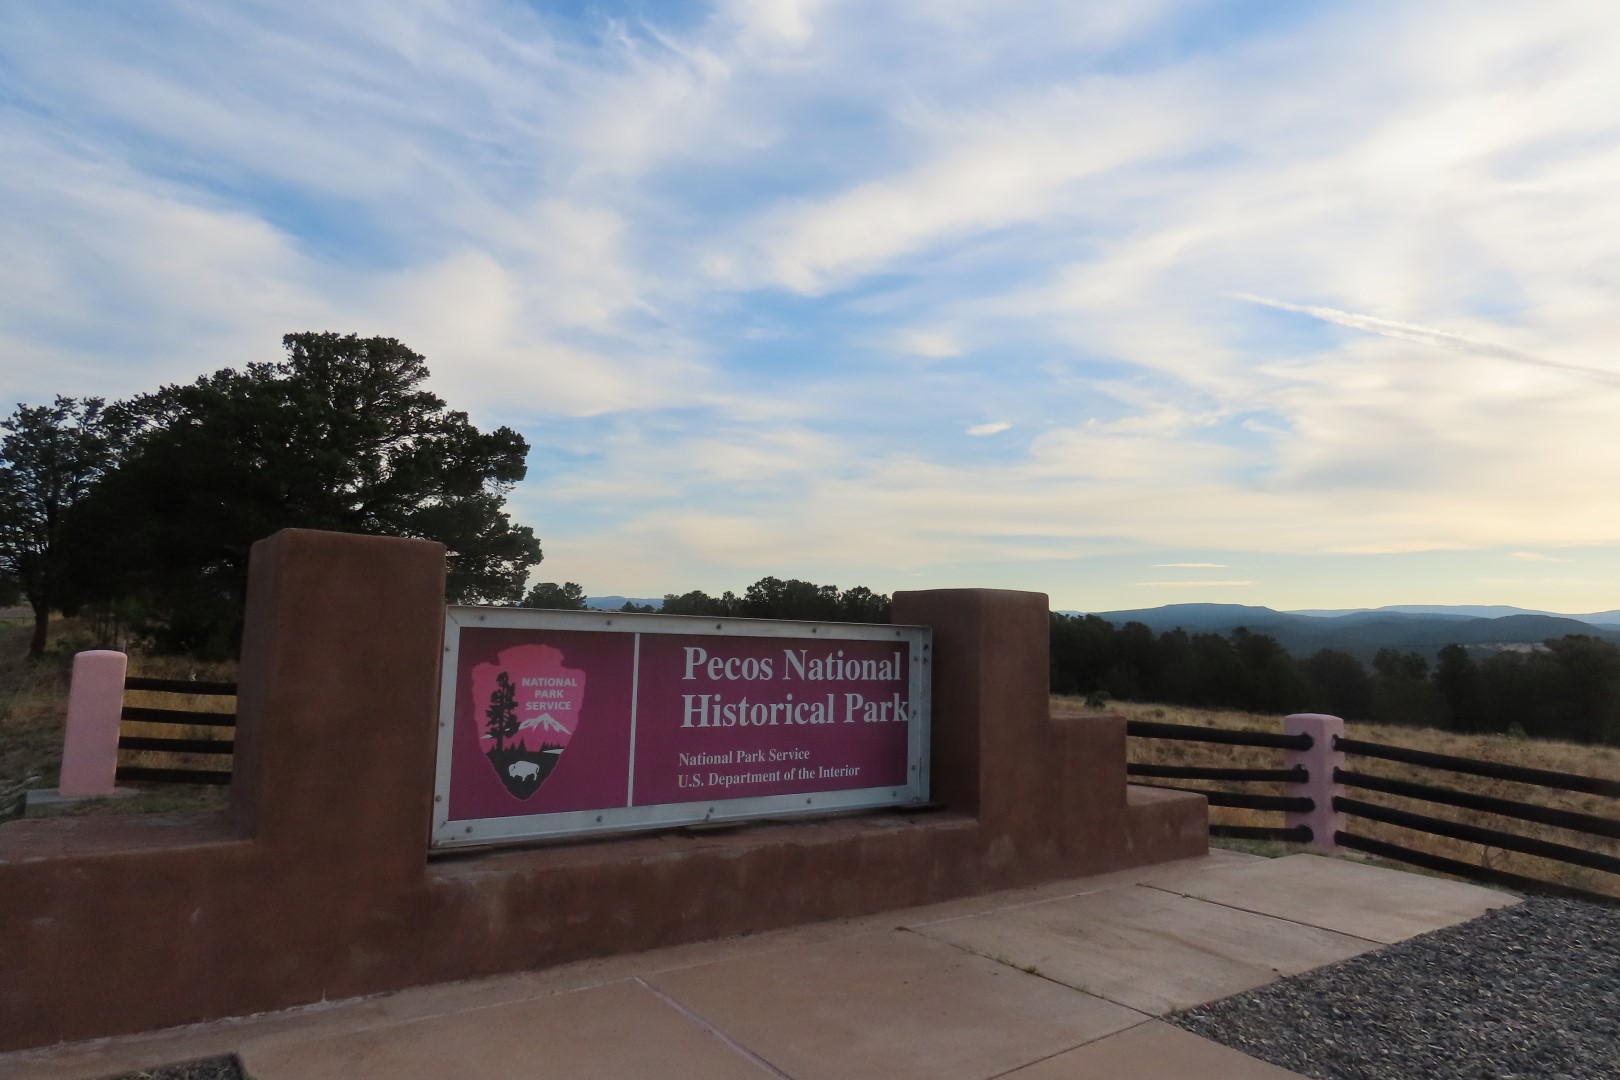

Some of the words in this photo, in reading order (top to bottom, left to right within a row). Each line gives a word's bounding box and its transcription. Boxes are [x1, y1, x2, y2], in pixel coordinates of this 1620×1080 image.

[681, 646, 773, 681] Pecos
[782, 649, 901, 681] National
[522, 677, 578, 687] NATIONAL
[534, 689, 564, 699] PARK
[525, 701, 572, 711] SERVICE
[680, 693, 835, 728] Historical
[843, 692, 909, 723] Park
[679, 750, 733, 767] National
[736, 749, 766, 763] Park
[768, 747, 810, 761] Service
[678, 773, 704, 788] U.S.
[708, 770, 780, 788] Department
[783, 767, 796, 781] of
[798, 767, 816, 779] the
[818, 764, 860, 778] Interior
